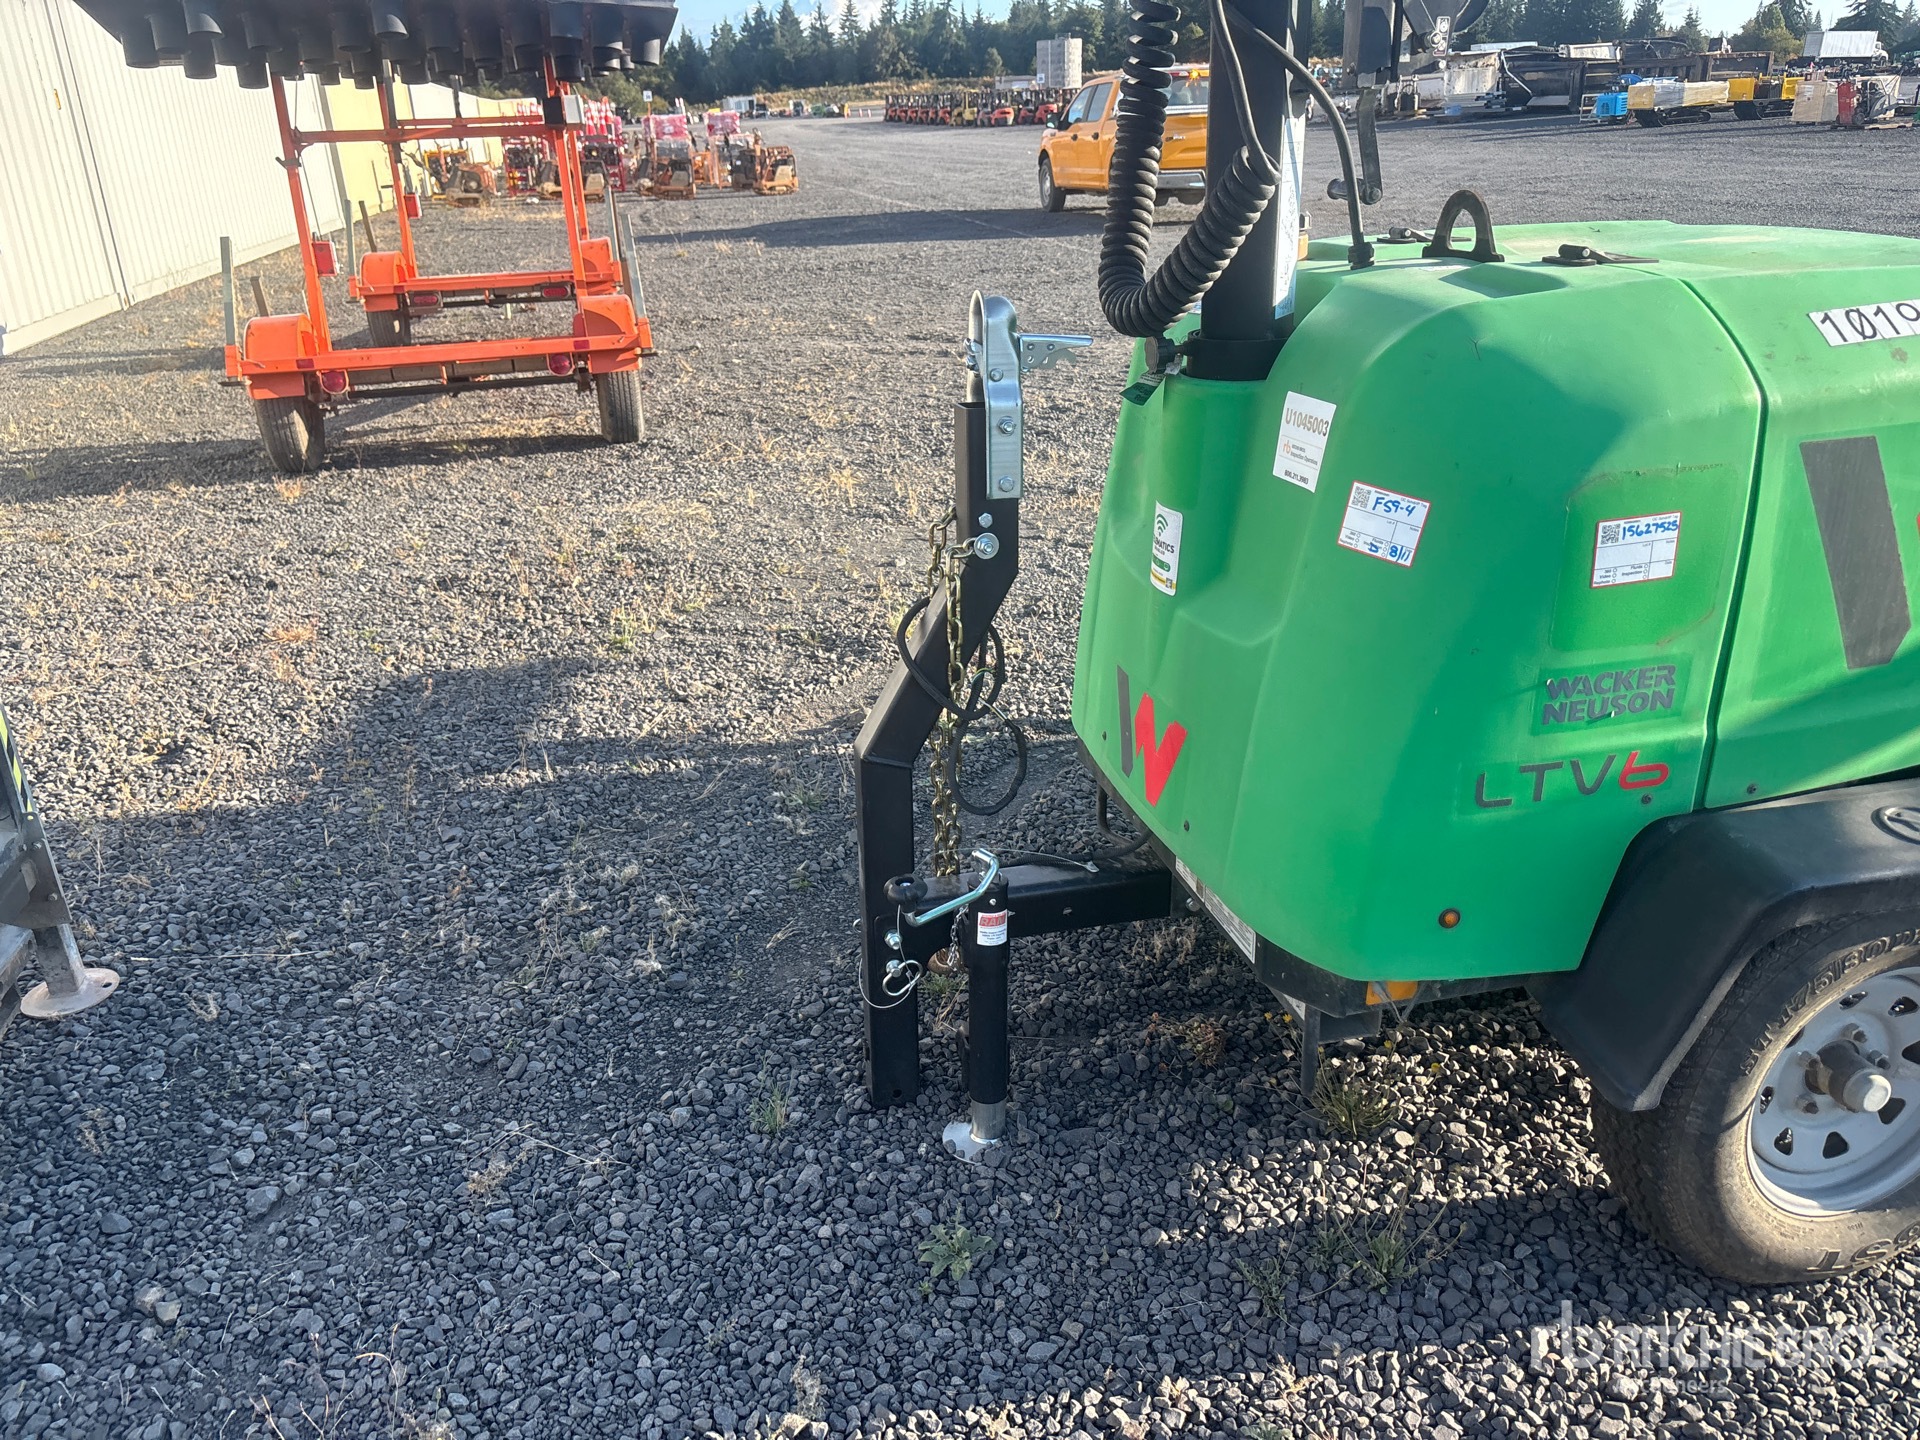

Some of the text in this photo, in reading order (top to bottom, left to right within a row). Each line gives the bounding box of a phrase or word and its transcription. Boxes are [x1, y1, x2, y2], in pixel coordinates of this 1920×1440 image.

[1285, 408, 1329, 437] U1045003
[1547, 664, 1676, 700] WACKER
[1542, 688, 1676, 725] NEUSON
